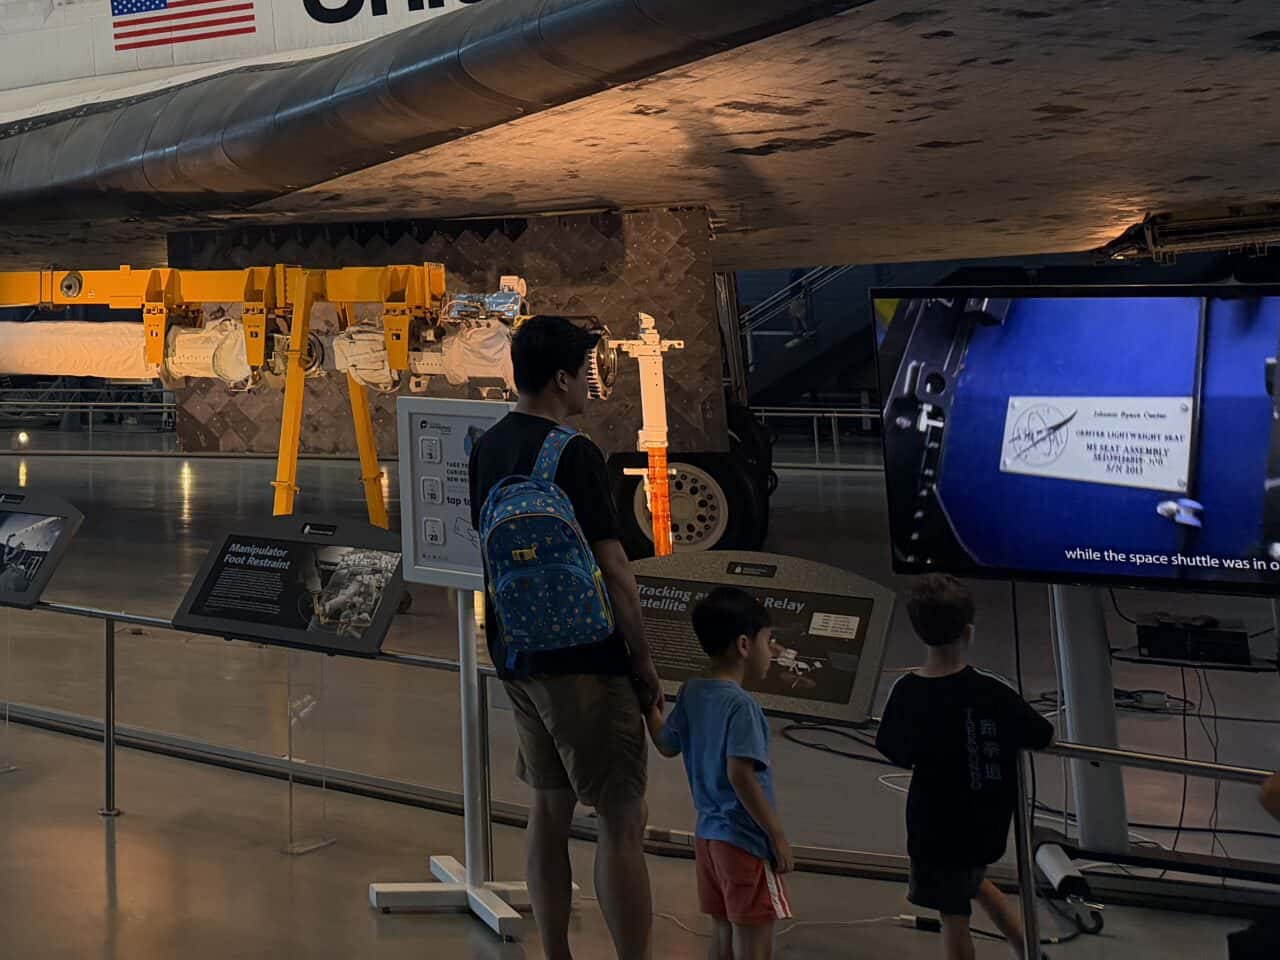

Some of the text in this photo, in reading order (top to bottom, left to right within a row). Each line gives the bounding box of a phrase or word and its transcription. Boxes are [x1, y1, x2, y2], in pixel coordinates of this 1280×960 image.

[1124, 445, 1170, 457] ASSEMBLY
[447, 496, 462, 507] tap
[228, 543, 289, 558] Manipulator
[223, 554, 290, 570] Foot Restraint
[1065, 547, 1101, 561] while
[1104, 549, 1126, 562] the
[1129, 553, 1169, 566] space
[1171, 553, 1220, 568] shuttle
[1222, 559, 1250, 570] was
[1253, 557, 1267, 571] in
[637, 584, 692, 602] Tracking
[764, 596, 806, 615] Relay
[639, 597, 687, 613] atellite
